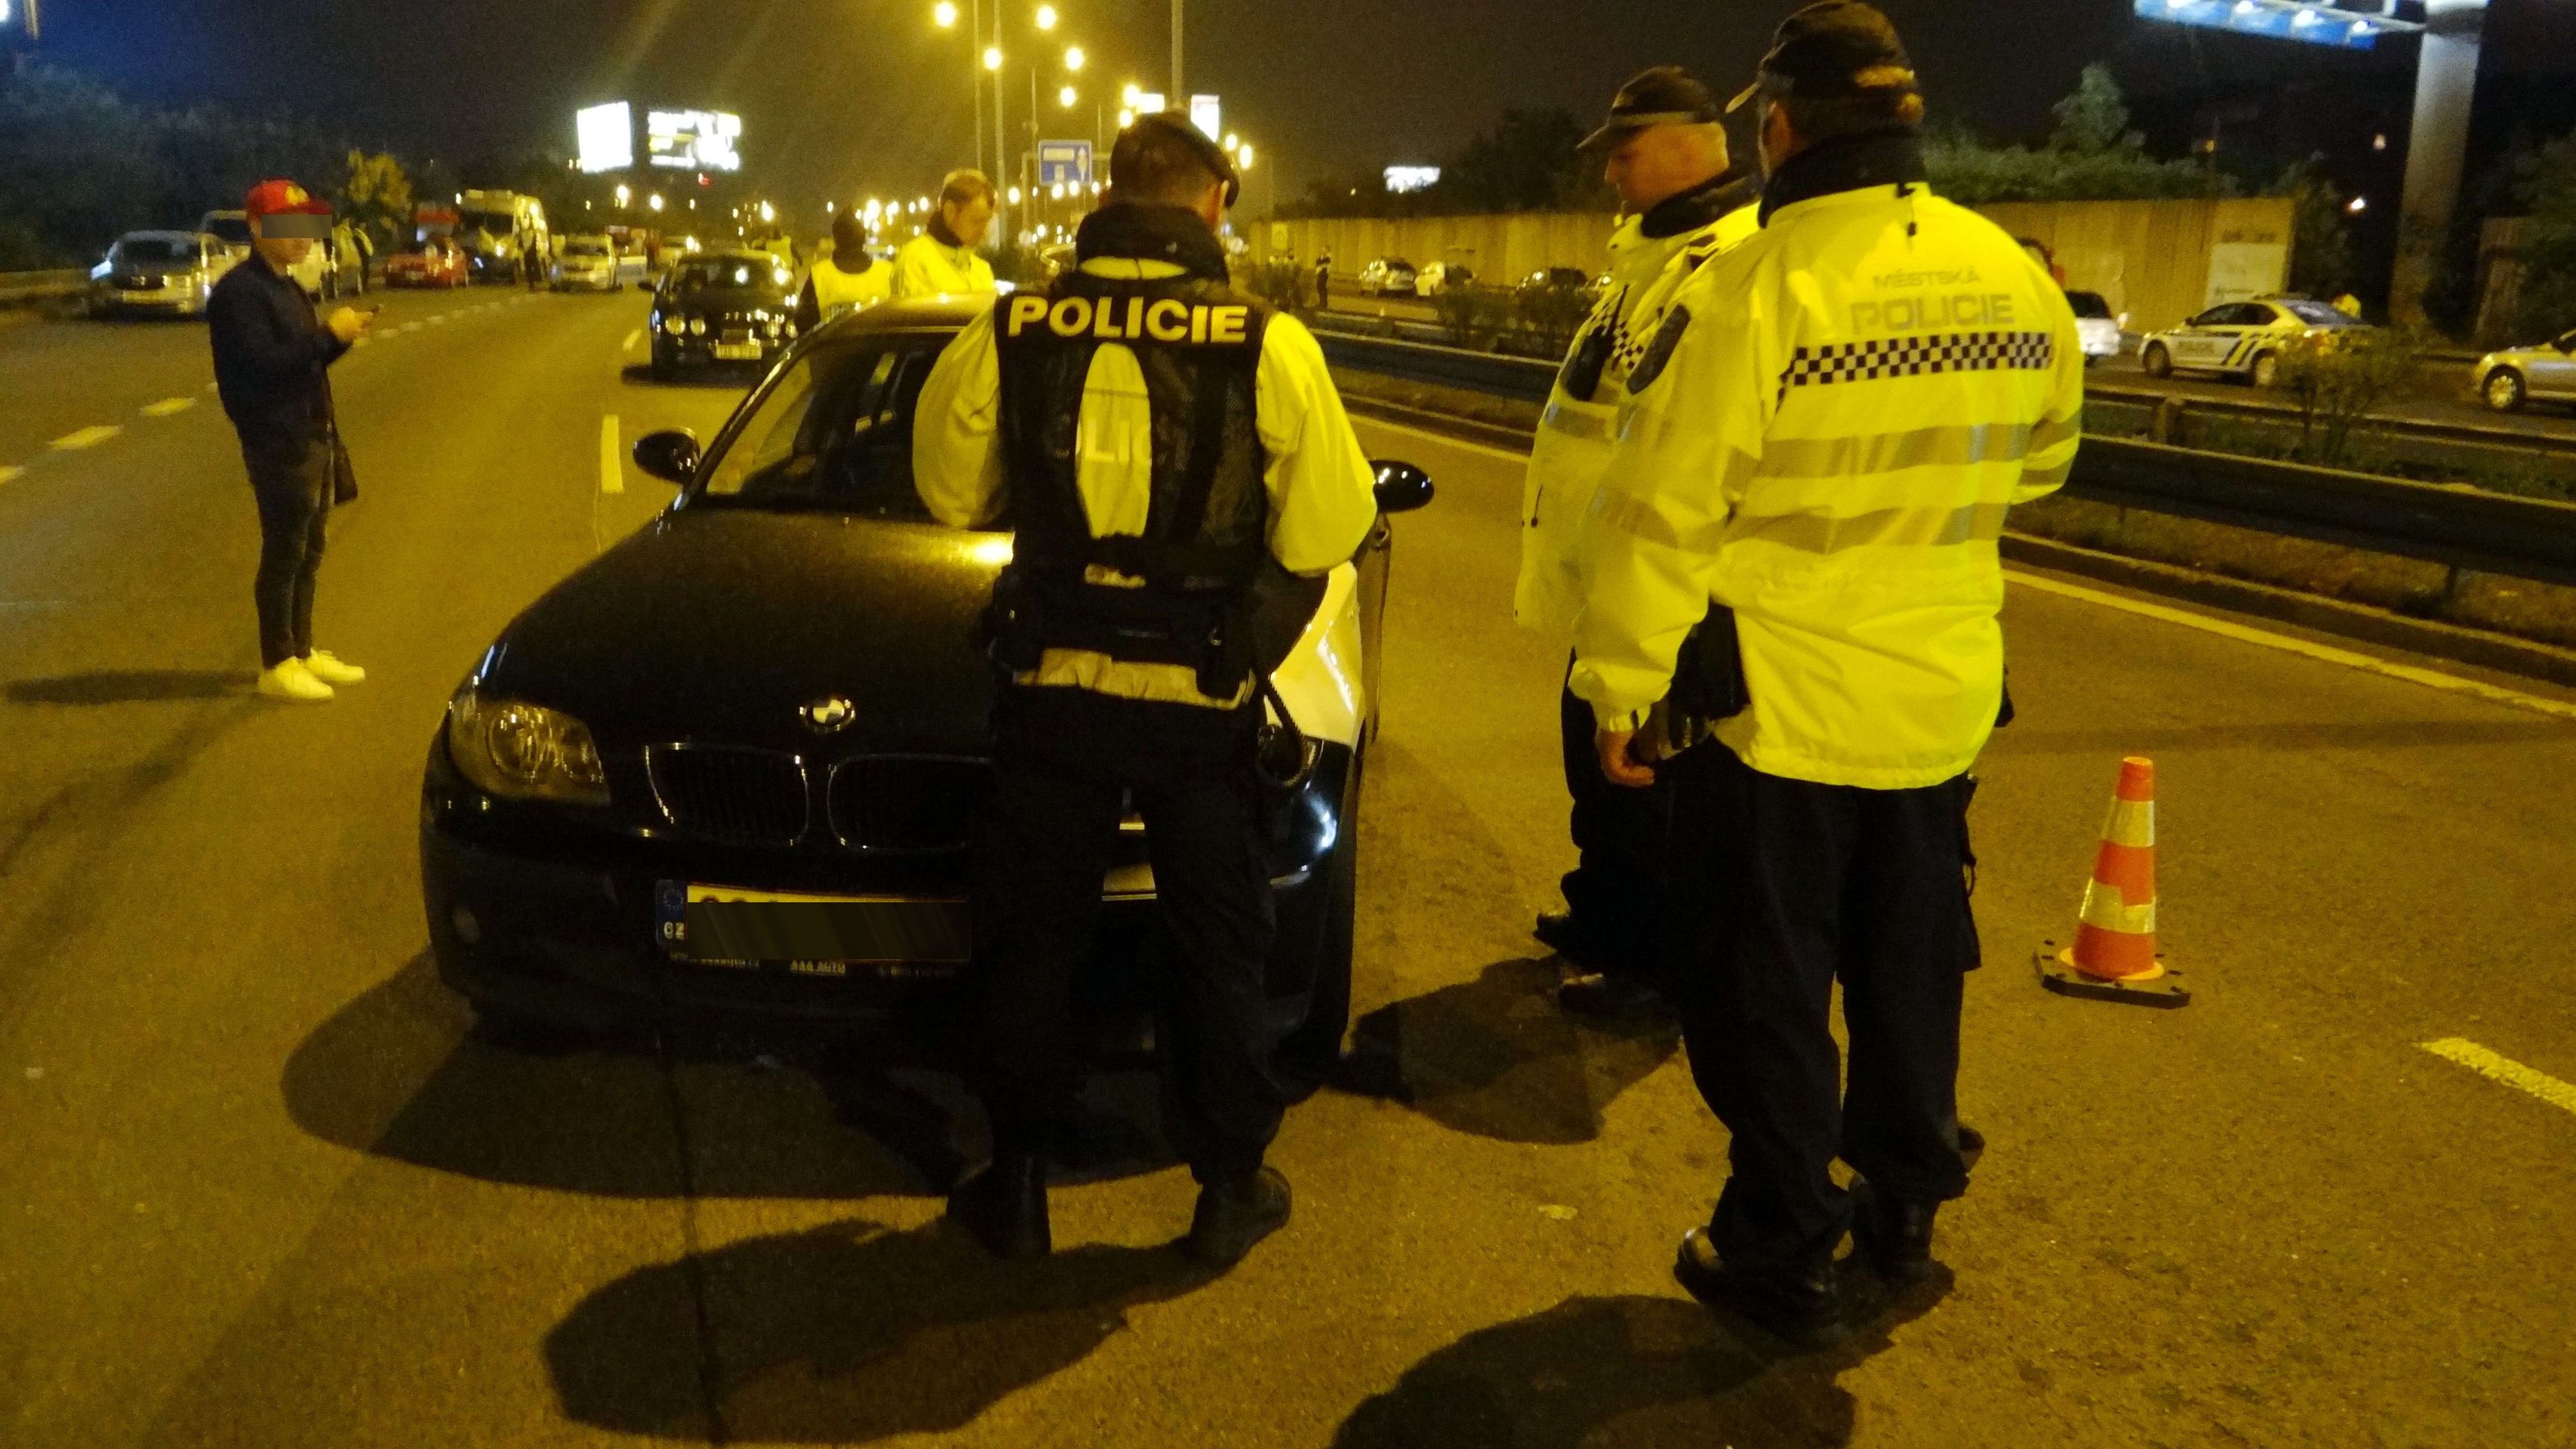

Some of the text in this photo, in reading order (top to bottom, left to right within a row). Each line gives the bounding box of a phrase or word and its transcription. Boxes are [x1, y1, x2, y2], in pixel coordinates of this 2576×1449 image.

[1008, 296, 1248, 343] POLICIE
[1851, 294, 2014, 335] POLICIE
[790, 959, 814, 972] AAA
